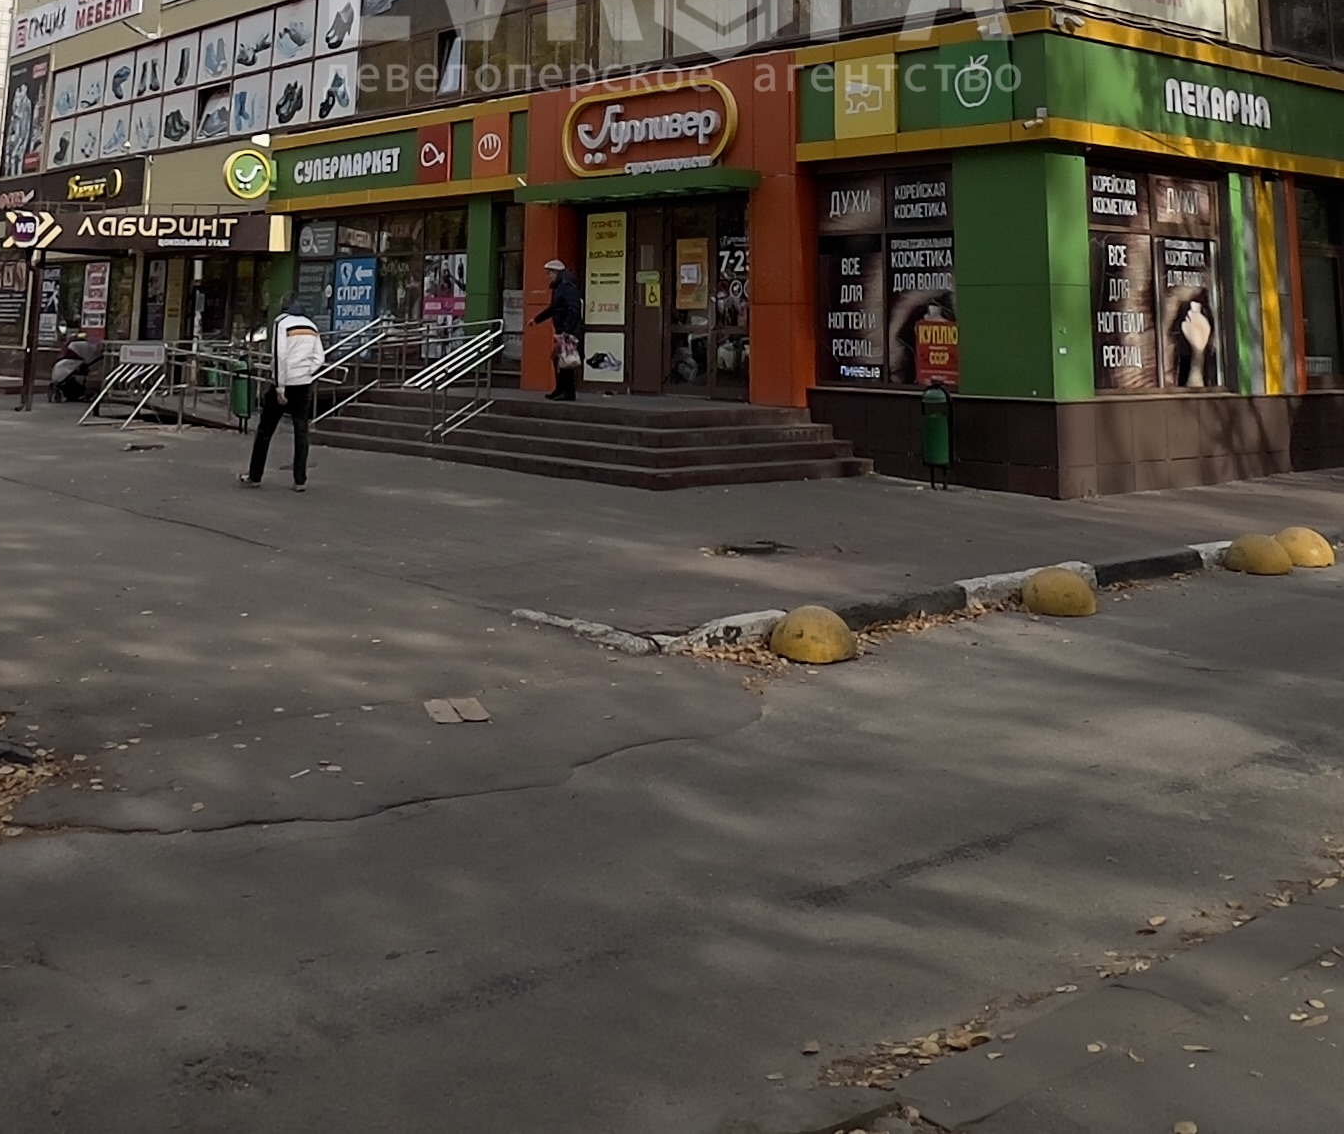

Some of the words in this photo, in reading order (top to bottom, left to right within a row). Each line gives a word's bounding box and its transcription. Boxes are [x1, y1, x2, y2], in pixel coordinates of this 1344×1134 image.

[1165, 78, 1271, 129] ПЕКАРНЯ
[577, 104, 721, 154] Гулливер
[294, 147, 400, 184] СУПЕРМАРКЕТ
[895, 181, 946, 199] КОРЕЙСКАЯ
[830, 189, 871, 218] ДУХИ
[894, 202, 947, 218] КОСМЕТИКА
[1092, 197, 1137, 215] КОСМЕТИКА
[16, 222, 35, 233] WB
[891, 249, 953, 268] КОСМЕТИКА
[1108, 245, 1127, 266] ВСЕ
[841, 257, 860, 275] ВСЕ
[893, 273, 915, 292] ДЛЯ
[917, 272, 953, 290] ВОЛОС
[1109, 278, 1131, 302] ДЛЯ
[337, 285, 372, 301] СПОРТ
[840, 285, 863, 304] ДЛЯ
[828, 310, 866, 329] НОГТЕЙ
[1097, 309, 1135, 333] НОГТЕЙ
[919, 326, 959, 345] КУПЛЮ
[832, 339, 872, 357] РЕСНИЦ
[1103, 345, 1143, 368] РЕСНИЦ
